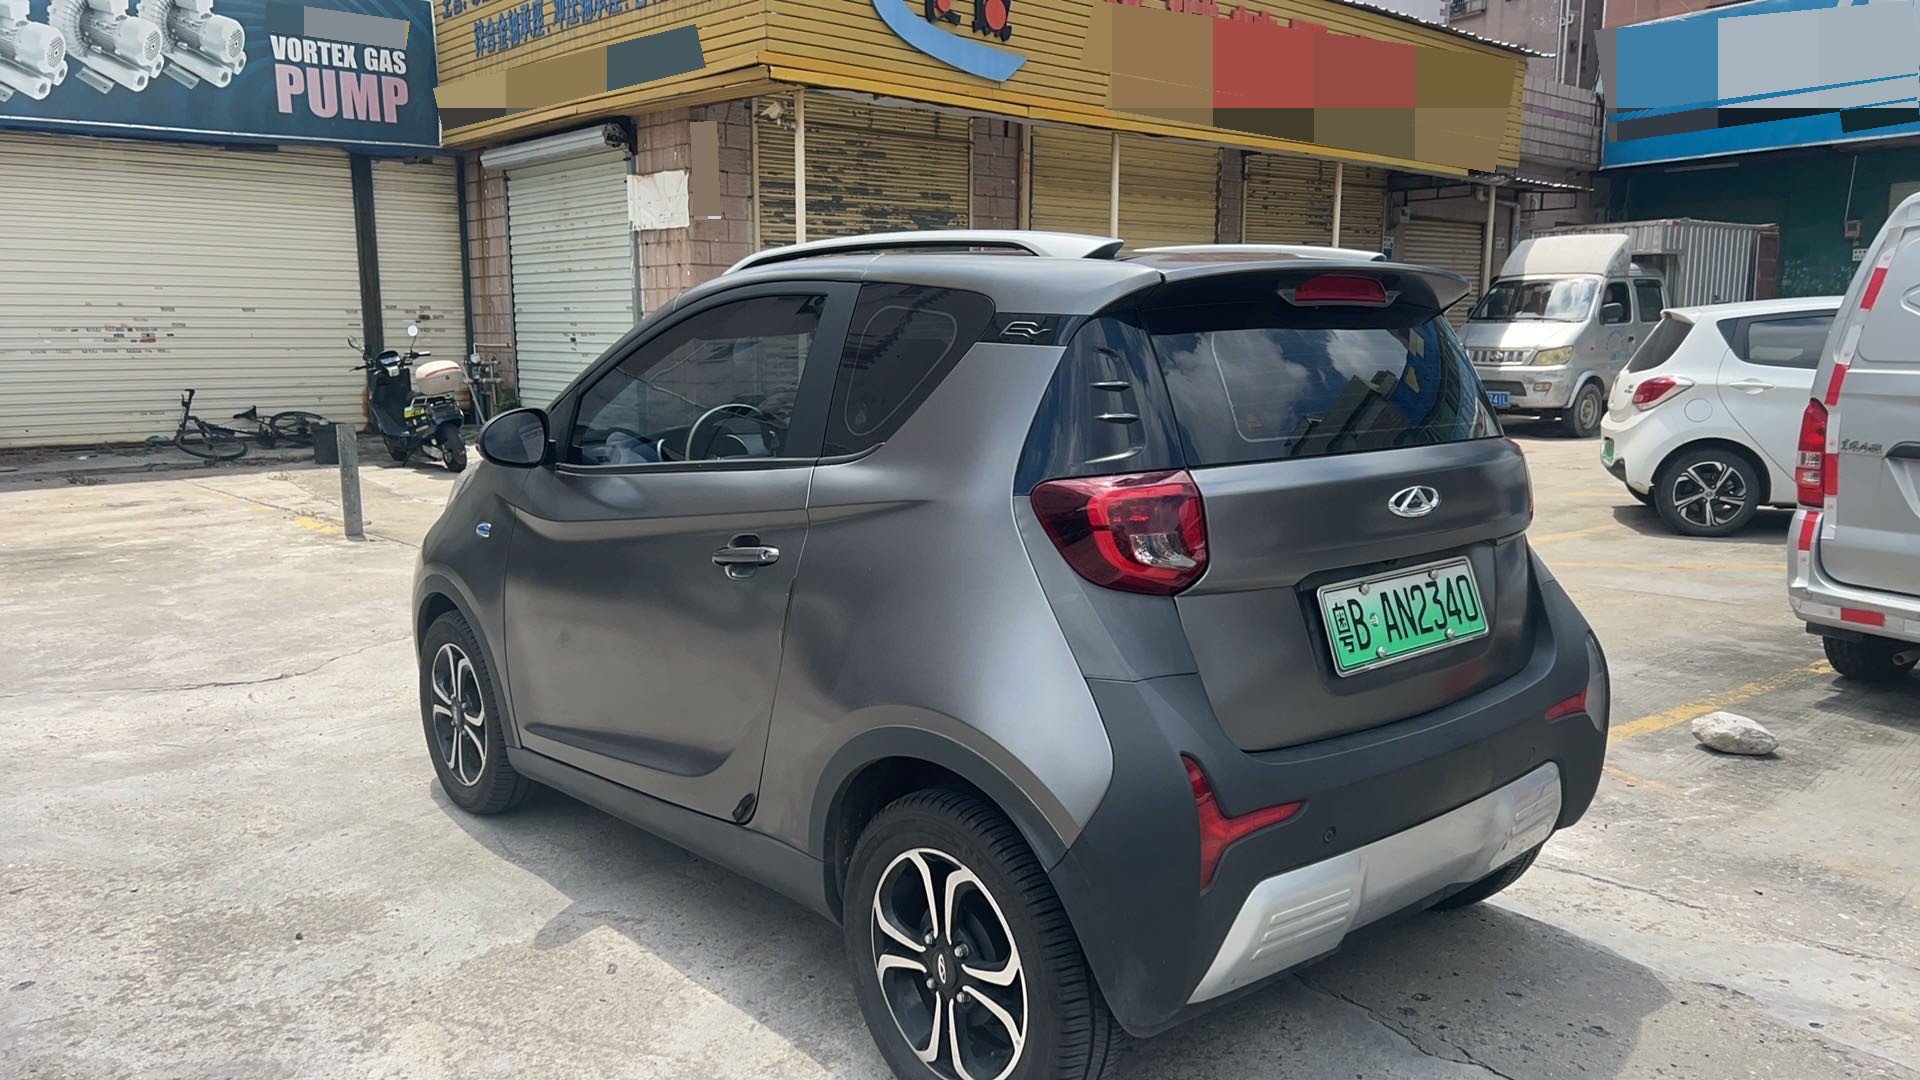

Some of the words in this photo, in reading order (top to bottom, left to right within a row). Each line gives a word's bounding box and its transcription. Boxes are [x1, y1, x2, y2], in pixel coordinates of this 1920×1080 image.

[270, 35, 357, 69] VORTEX
[364, 47, 407, 75] GAS
[275, 63, 408, 124] PUMP
[1379, 574, 1479, 643] AN2340
